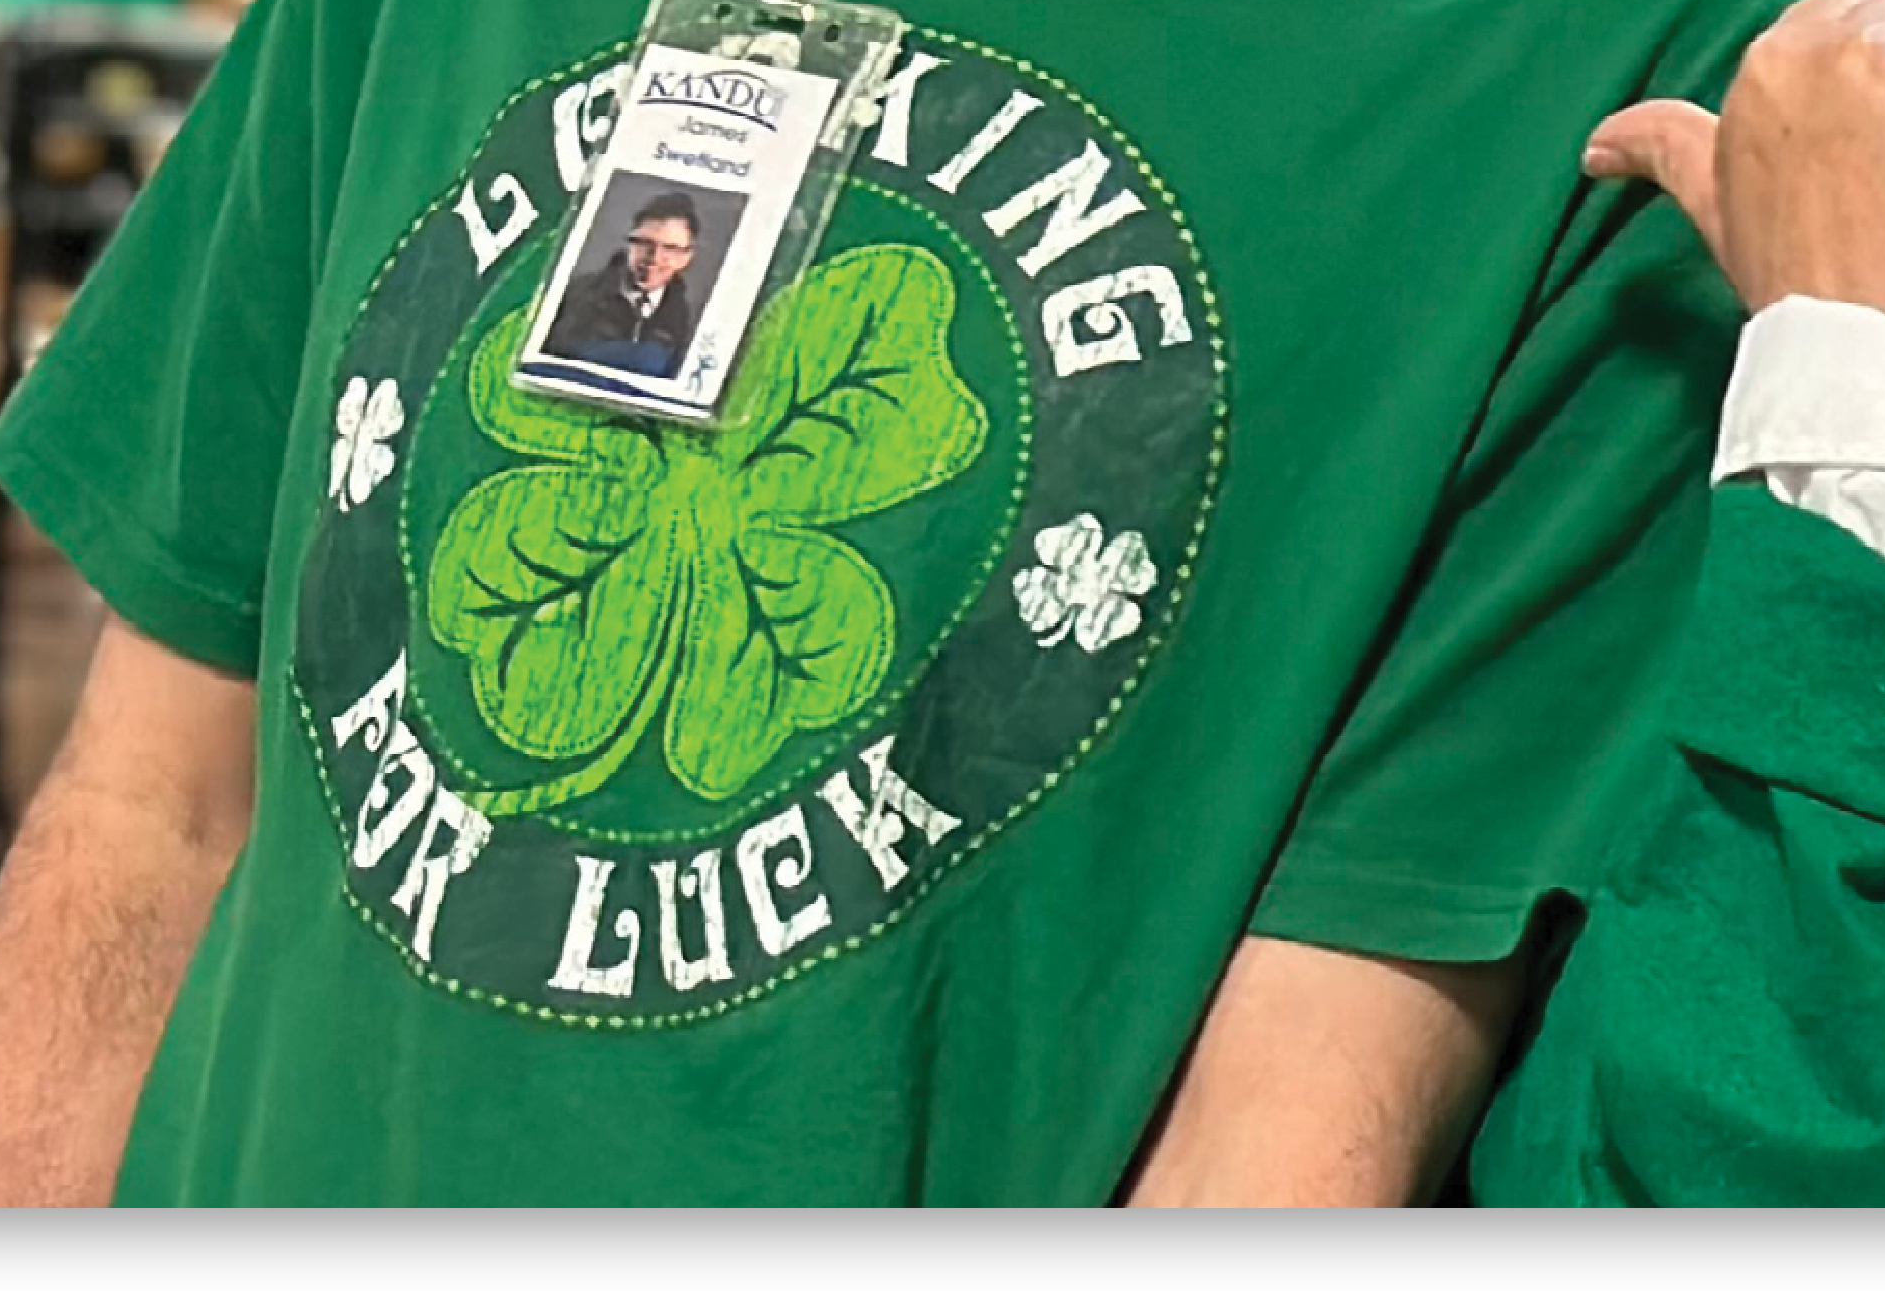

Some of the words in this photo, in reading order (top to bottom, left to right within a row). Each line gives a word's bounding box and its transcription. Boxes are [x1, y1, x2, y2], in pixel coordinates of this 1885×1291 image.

[678, 115, 748, 143] James
[331, 647, 493, 961] FOR
[547, 734, 962, 997] LUCK
